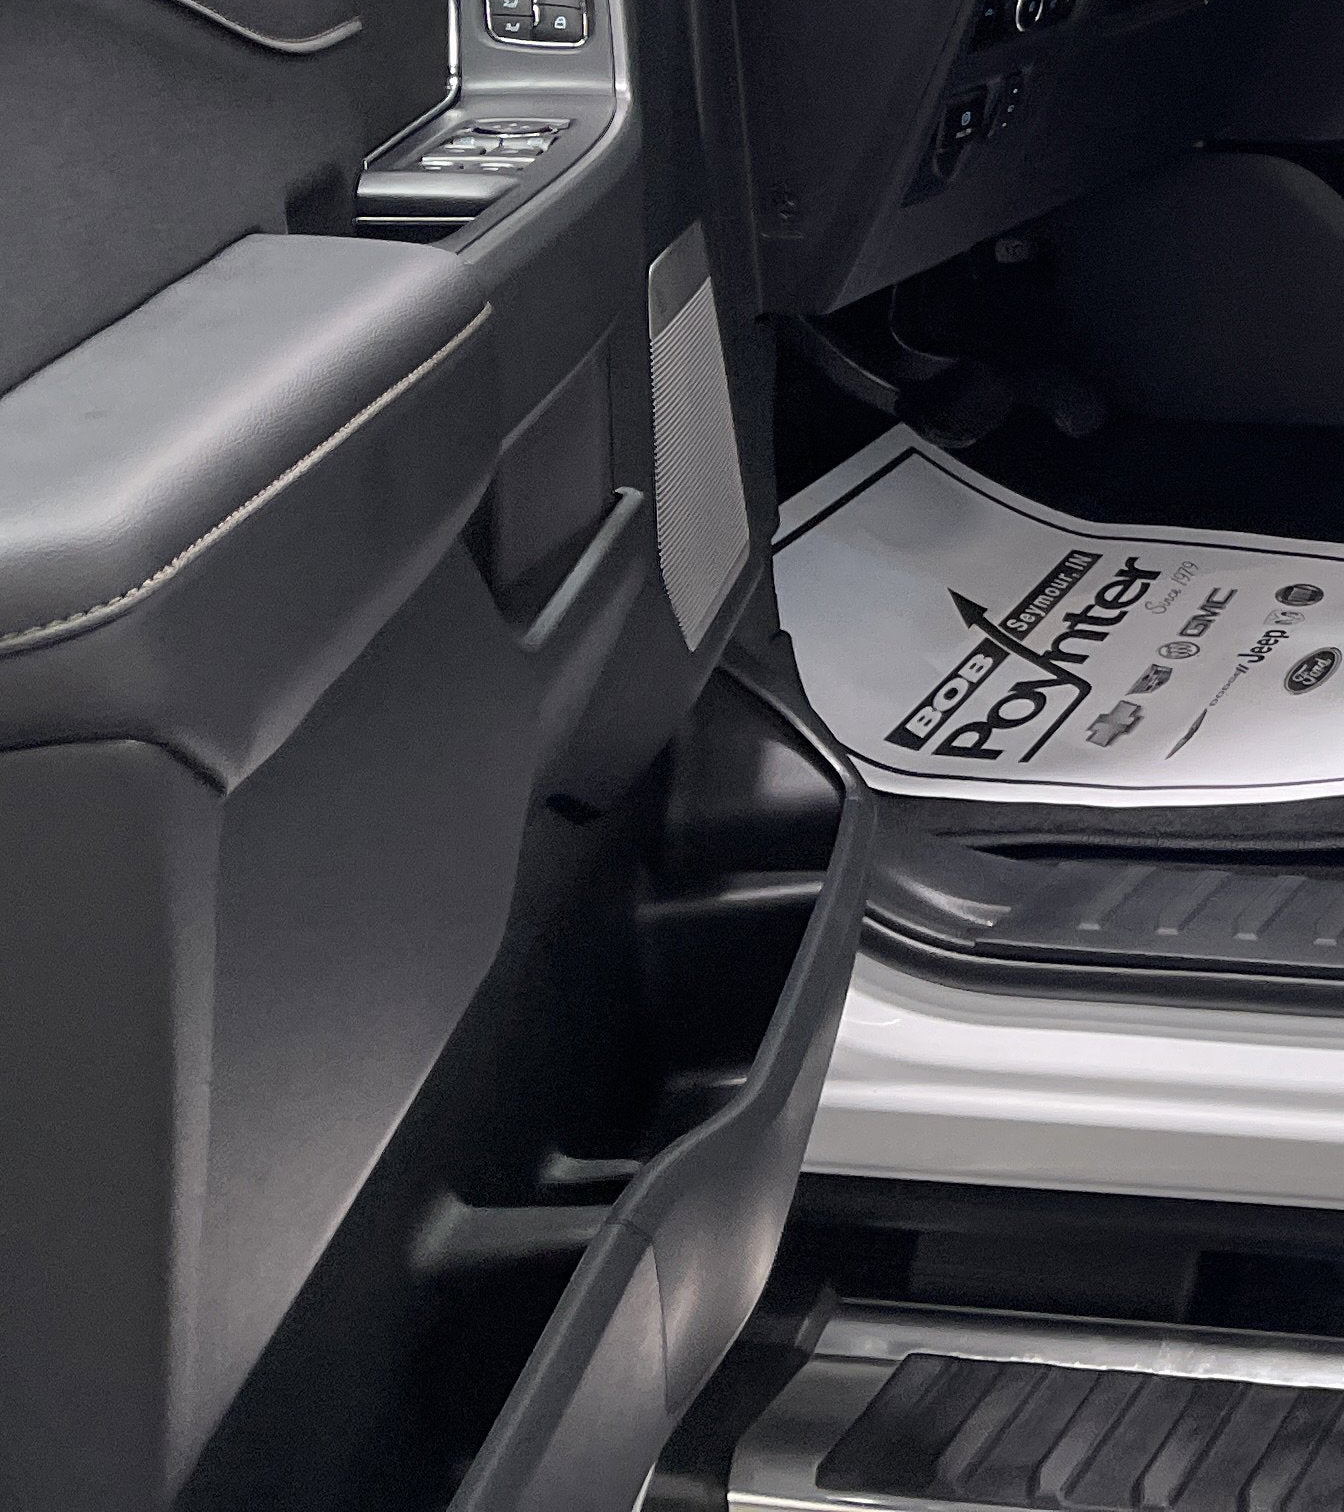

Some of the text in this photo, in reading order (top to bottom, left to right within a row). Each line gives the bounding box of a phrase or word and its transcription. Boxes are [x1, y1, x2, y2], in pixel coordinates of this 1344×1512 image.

[1006, 553, 1094, 633] Seymour, IN
[1170, 560, 1199, 587] 1979
[1177, 587, 1239, 637] GMC
[931, 556, 1162, 762] Poynter
[1237, 628, 1290, 664] Jeep
[904, 653, 994, 739] BOB
